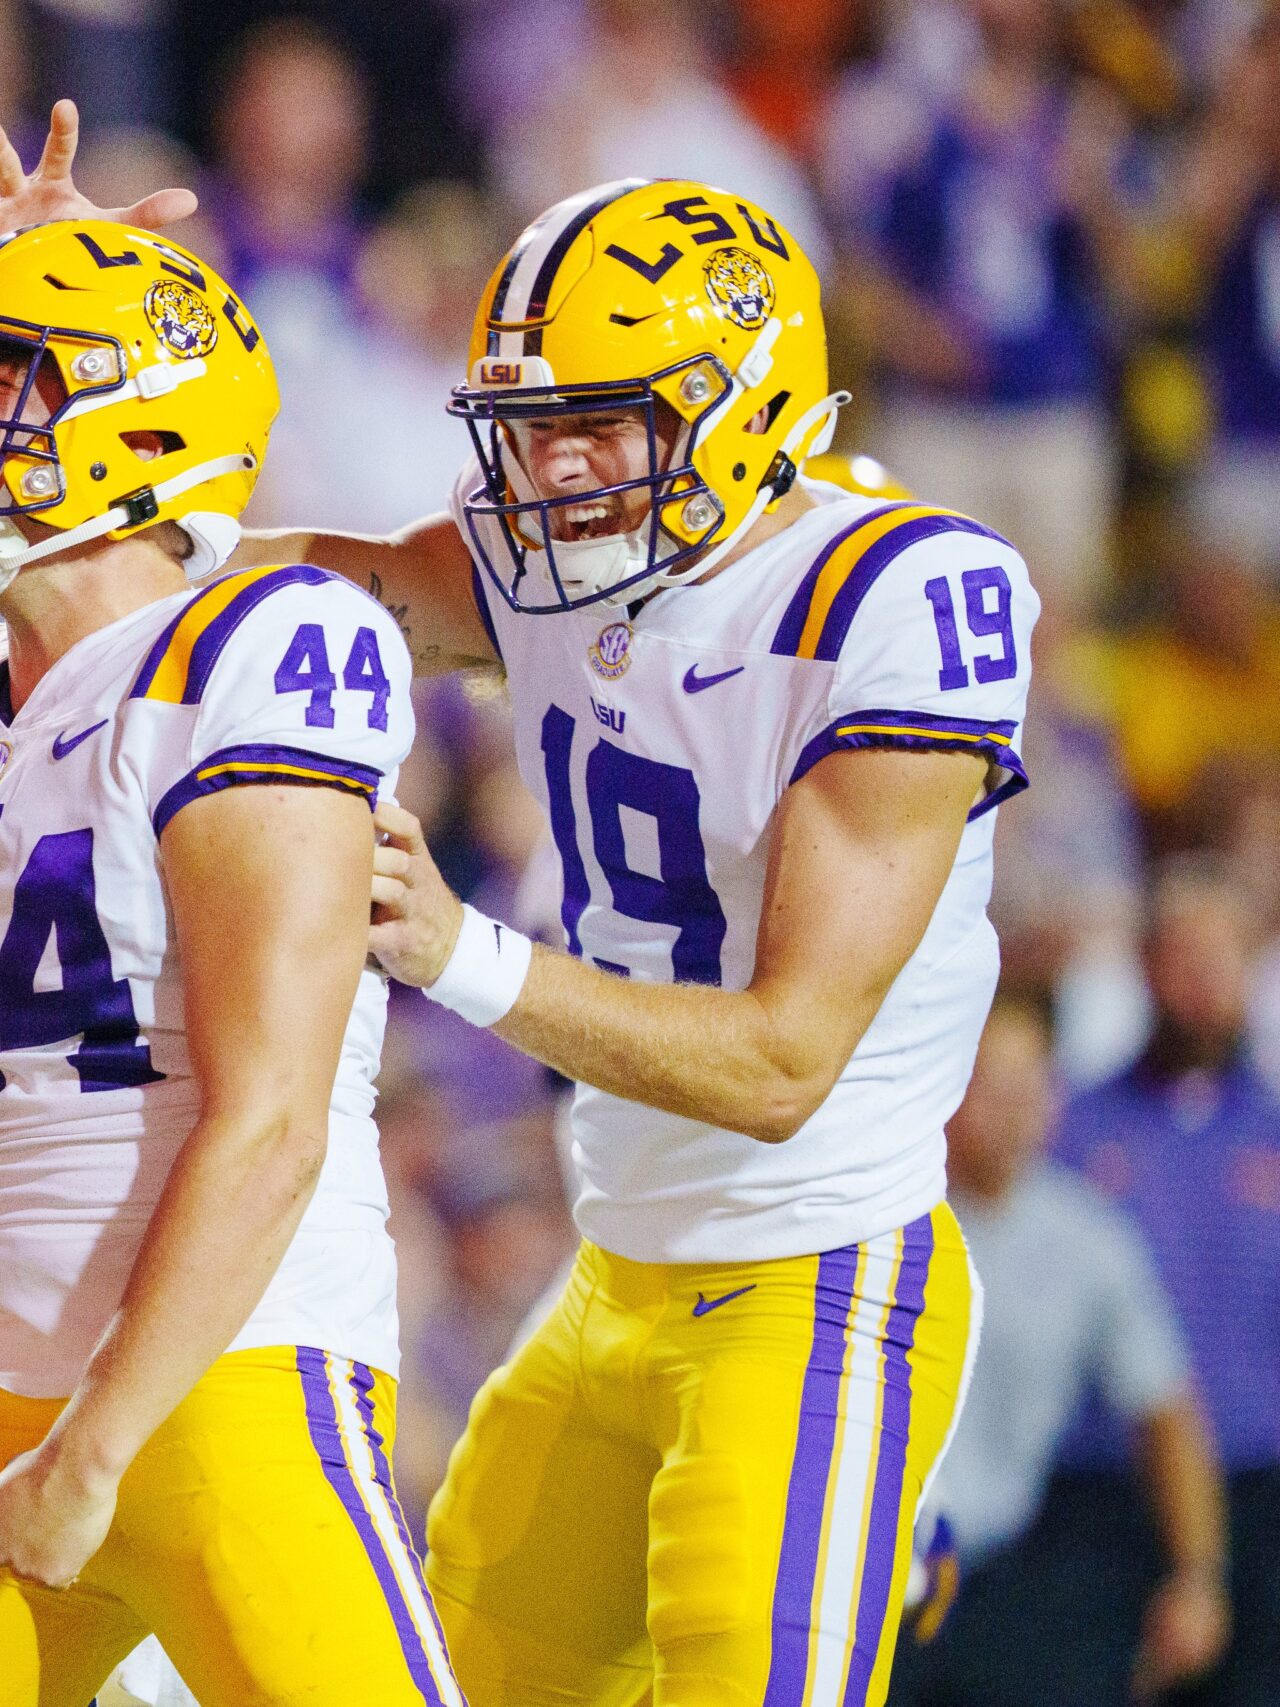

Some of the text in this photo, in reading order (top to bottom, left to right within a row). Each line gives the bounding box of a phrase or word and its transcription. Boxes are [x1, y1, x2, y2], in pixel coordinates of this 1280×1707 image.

[604, 196, 790, 285] LSU
[481, 364, 522, 384] LSU
[924, 565, 1017, 691] 19
[274, 623, 391, 733] 44
[590, 695, 626, 734] LSU
[540, 702, 728, 987] 19
